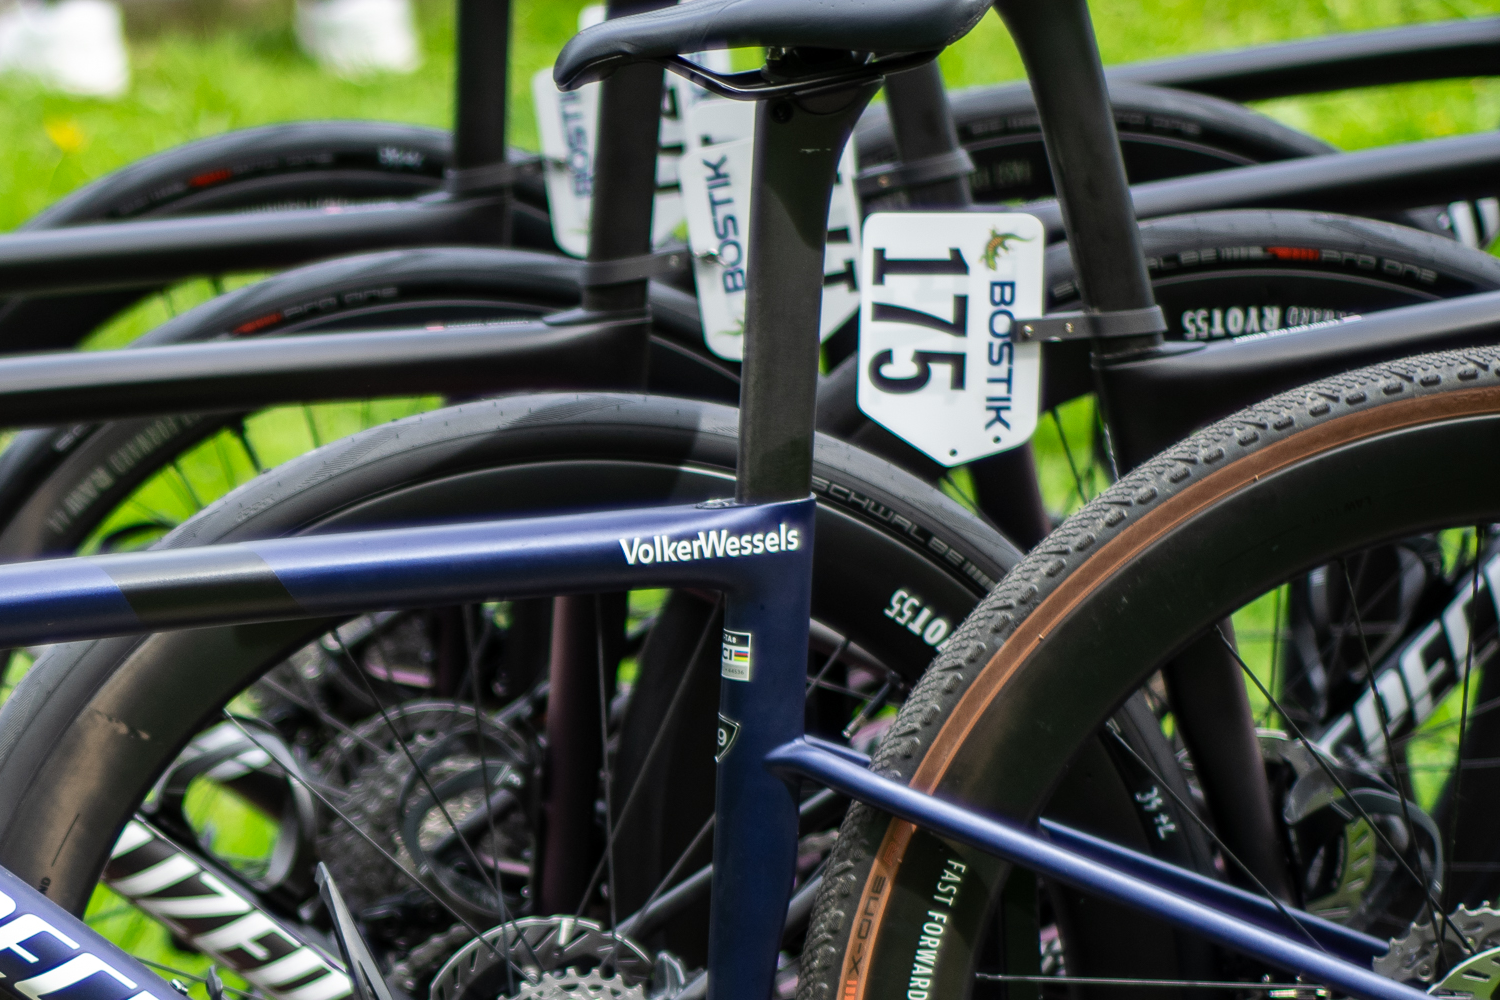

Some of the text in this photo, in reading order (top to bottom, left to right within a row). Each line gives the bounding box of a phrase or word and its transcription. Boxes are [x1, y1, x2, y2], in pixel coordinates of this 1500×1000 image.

[702, 153, 747, 294] BOSTIK
[868, 248, 970, 394] 175
[985, 280, 1016, 431] BOSTIK
[1181, 305, 1281, 342] RYOT55
[618, 522, 800, 565] VolkerWessels
[811, 475, 965, 566] SCHWALBE
[849, 875, 887, 976] X-ONE
[933, 859, 967, 907] FAST
